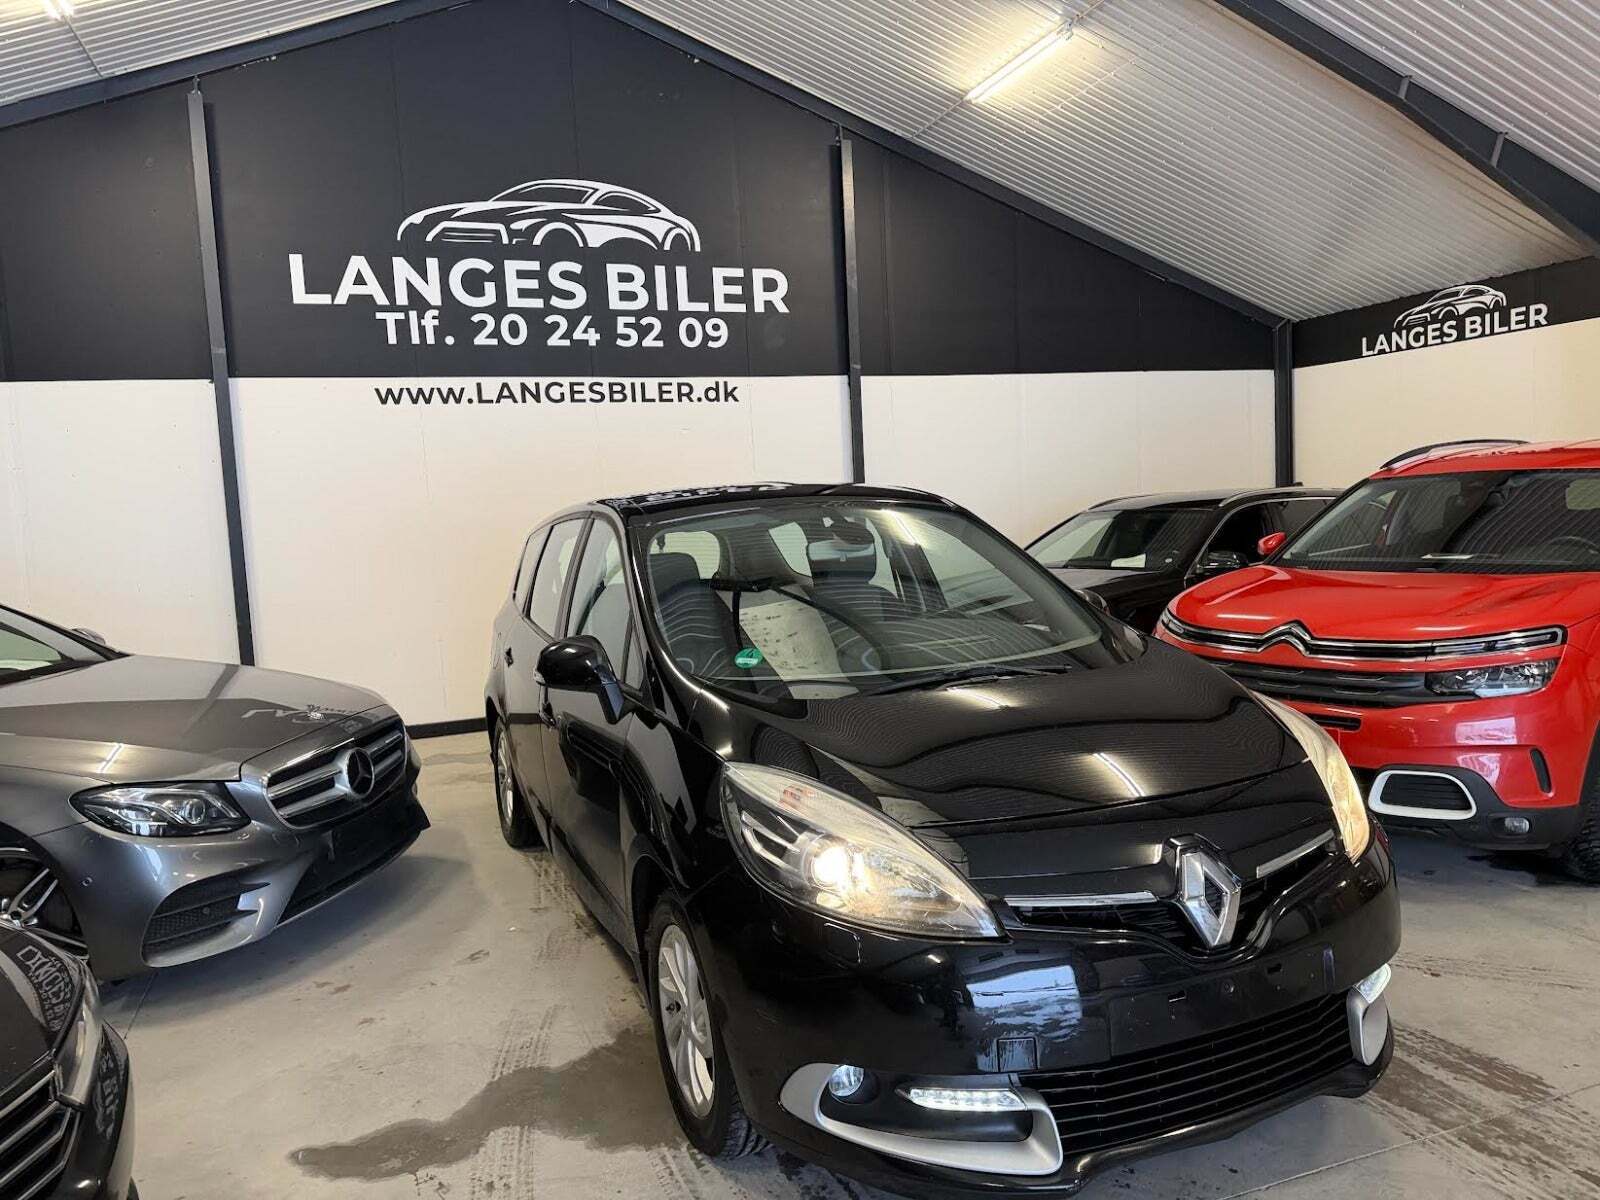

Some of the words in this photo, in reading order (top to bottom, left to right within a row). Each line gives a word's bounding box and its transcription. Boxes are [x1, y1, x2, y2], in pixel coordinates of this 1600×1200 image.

[288, 253, 587, 310] LANGES
[605, 262, 790, 314] BILER
[375, 308, 455, 346] Tlf.
[470, 312, 528, 347] 20
[543, 314, 601, 348] 24
[615, 315, 665, 348] 52
[678, 316, 729, 349] 09
[1361, 320, 1458, 357] LANGES
[1464, 303, 1549, 339] BILER
[374, 380, 740, 405] www.LANGESBILER.dk
